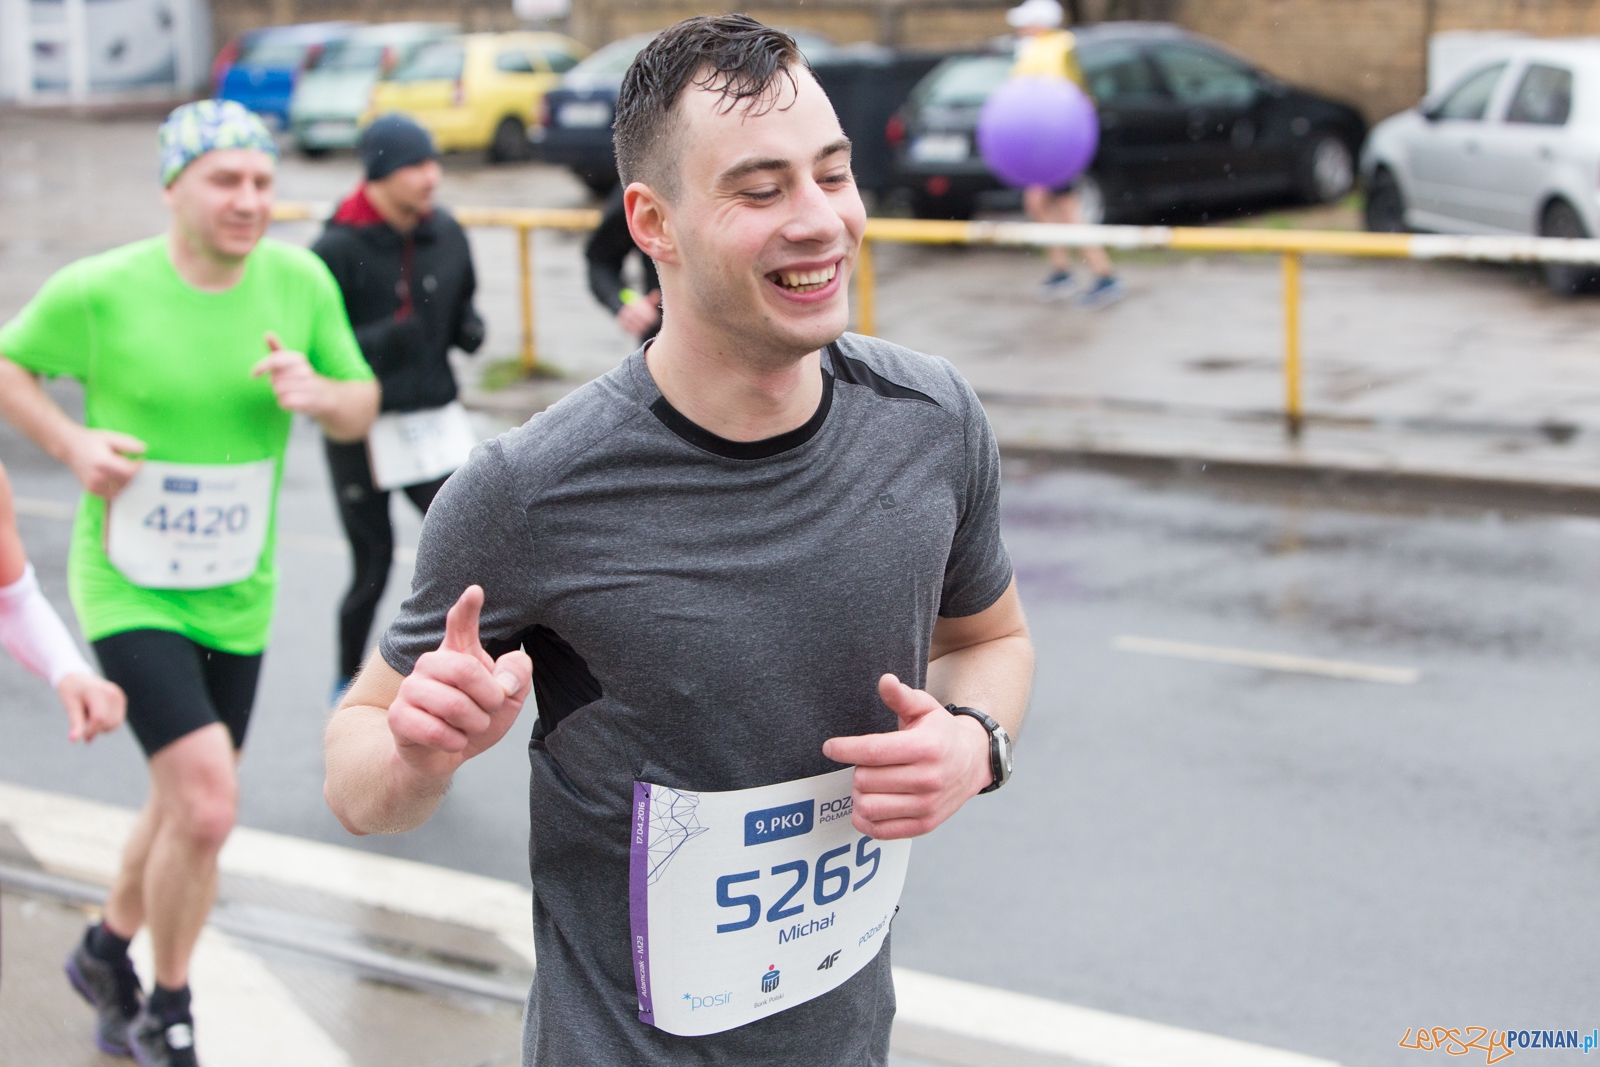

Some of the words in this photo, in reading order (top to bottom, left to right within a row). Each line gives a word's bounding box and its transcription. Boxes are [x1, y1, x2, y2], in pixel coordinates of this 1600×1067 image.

[143, 503, 249, 536] 4420
[770, 811, 805, 832] PKO
[819, 795, 854, 817] POZ
[819, 807, 854, 825] PÓŁMAR
[635, 801, 646, 845] 17.04.2016
[715, 834, 882, 934] 5265
[778, 911, 837, 945] Michał
[636, 935, 644, 955] M23
[638, 960, 648, 998] Adamczak
